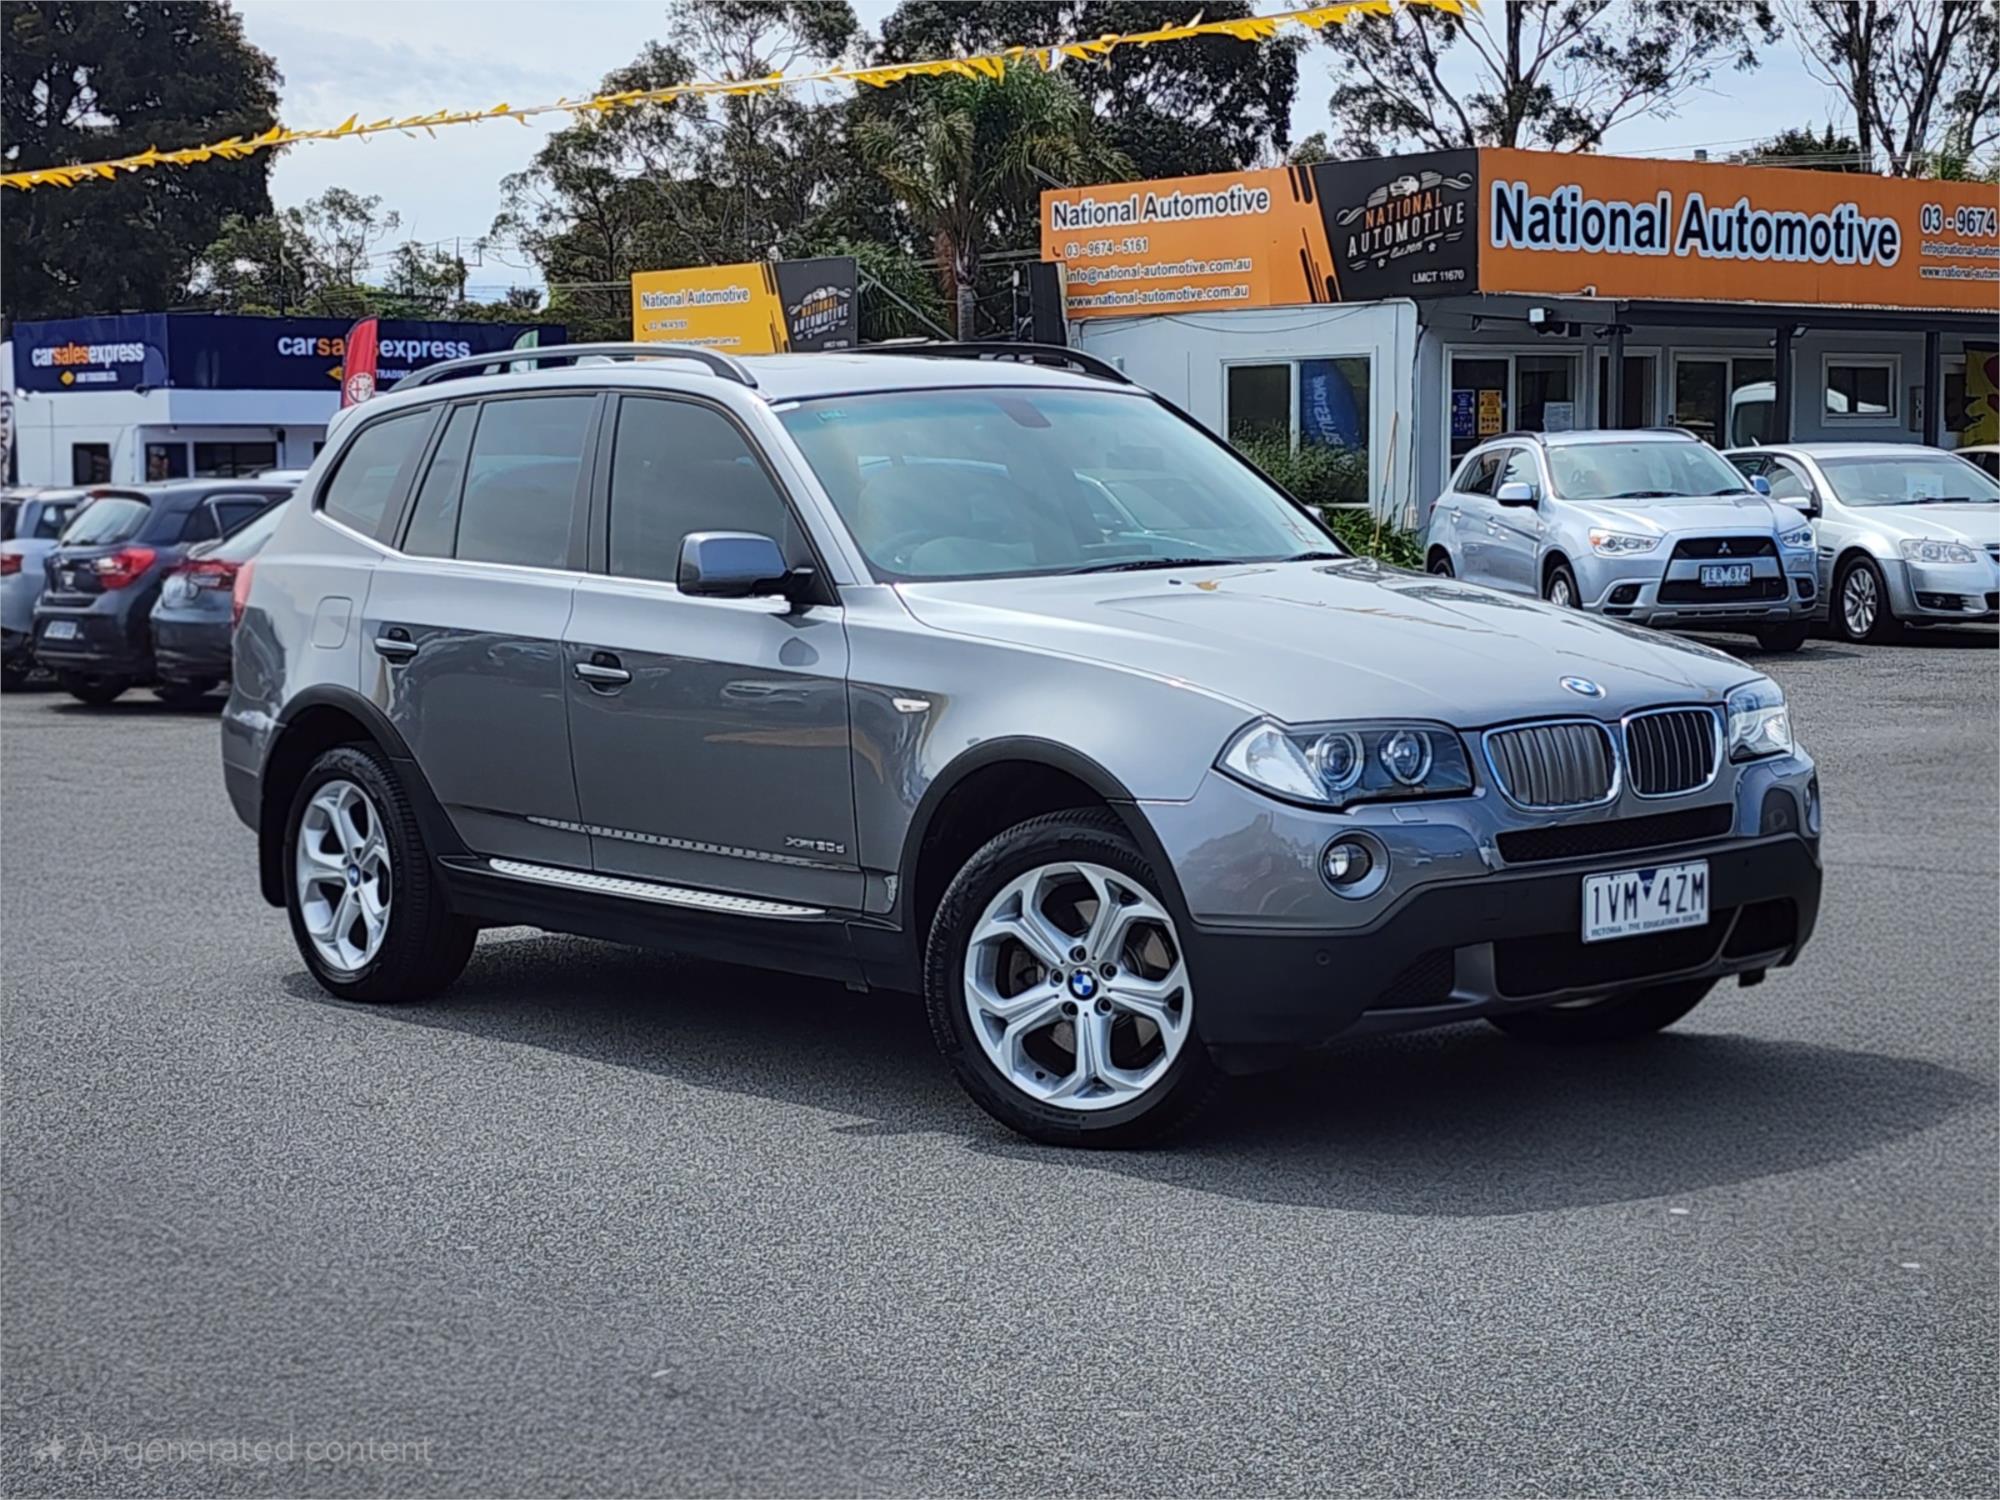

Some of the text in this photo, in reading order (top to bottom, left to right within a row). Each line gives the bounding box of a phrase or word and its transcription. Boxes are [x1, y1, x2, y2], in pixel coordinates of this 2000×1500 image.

[1053, 186, 1269, 228] National Automotive
[1365, 188, 1442, 230] NATIONAL
[1922, 206, 1942, 232] 03
[1956, 208, 1996, 234] 9674
[1347, 201, 1465, 258] AUTOMOTIVE
[1495, 186, 1898, 261] National Automotive
[1066, 244, 1079, 257] 03
[1087, 242, 1113, 255] 9674
[1122, 239, 1148, 252] 5161
[1067, 259, 1251, 283] info@national-automotive.com.au
[1412, 270, 1465, 283] LMCT 11670
[642, 286, 749, 308] National Automotive
[1067, 286, 1248, 307] www.national-automotive.com.au
[793, 303, 849, 333] AUTOMOTIVE
[32, 342, 144, 369] carsalesexpress
[278, 336, 471, 362] carsaexpress
[1592, 871, 1705, 926] 1VM 4ZM
